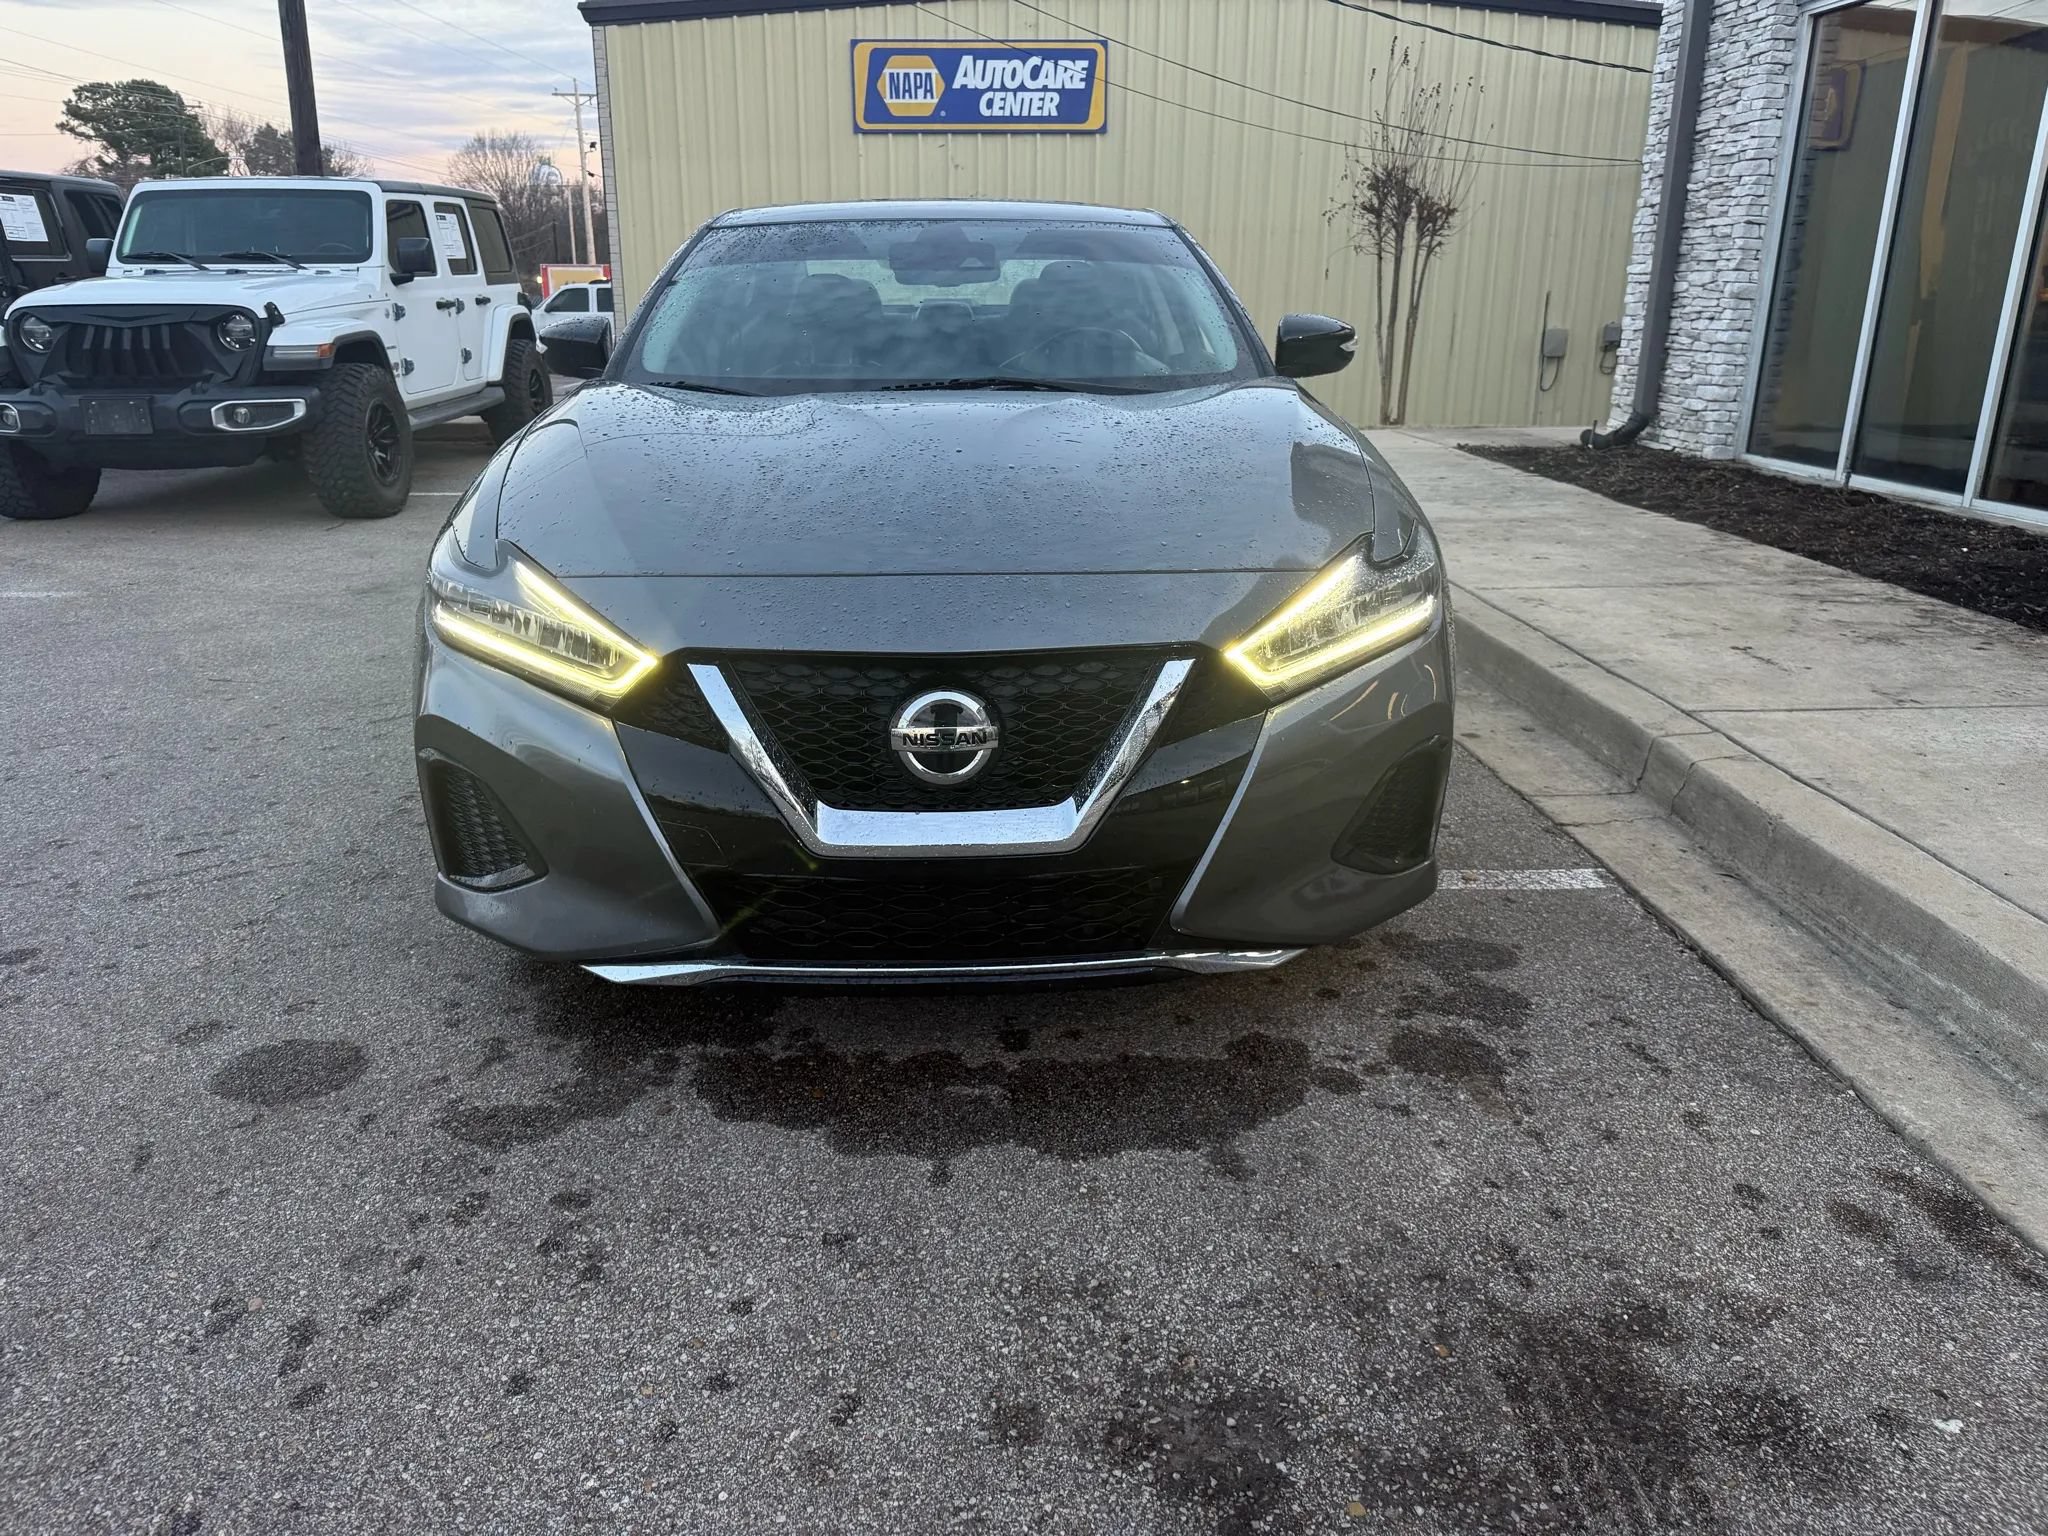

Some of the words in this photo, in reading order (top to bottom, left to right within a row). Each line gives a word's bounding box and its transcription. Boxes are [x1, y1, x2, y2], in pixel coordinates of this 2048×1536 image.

[889, 72, 934, 100] NAPA
[979, 91, 1060, 116] CENTER
[902, 732, 987, 746] NISSAN
